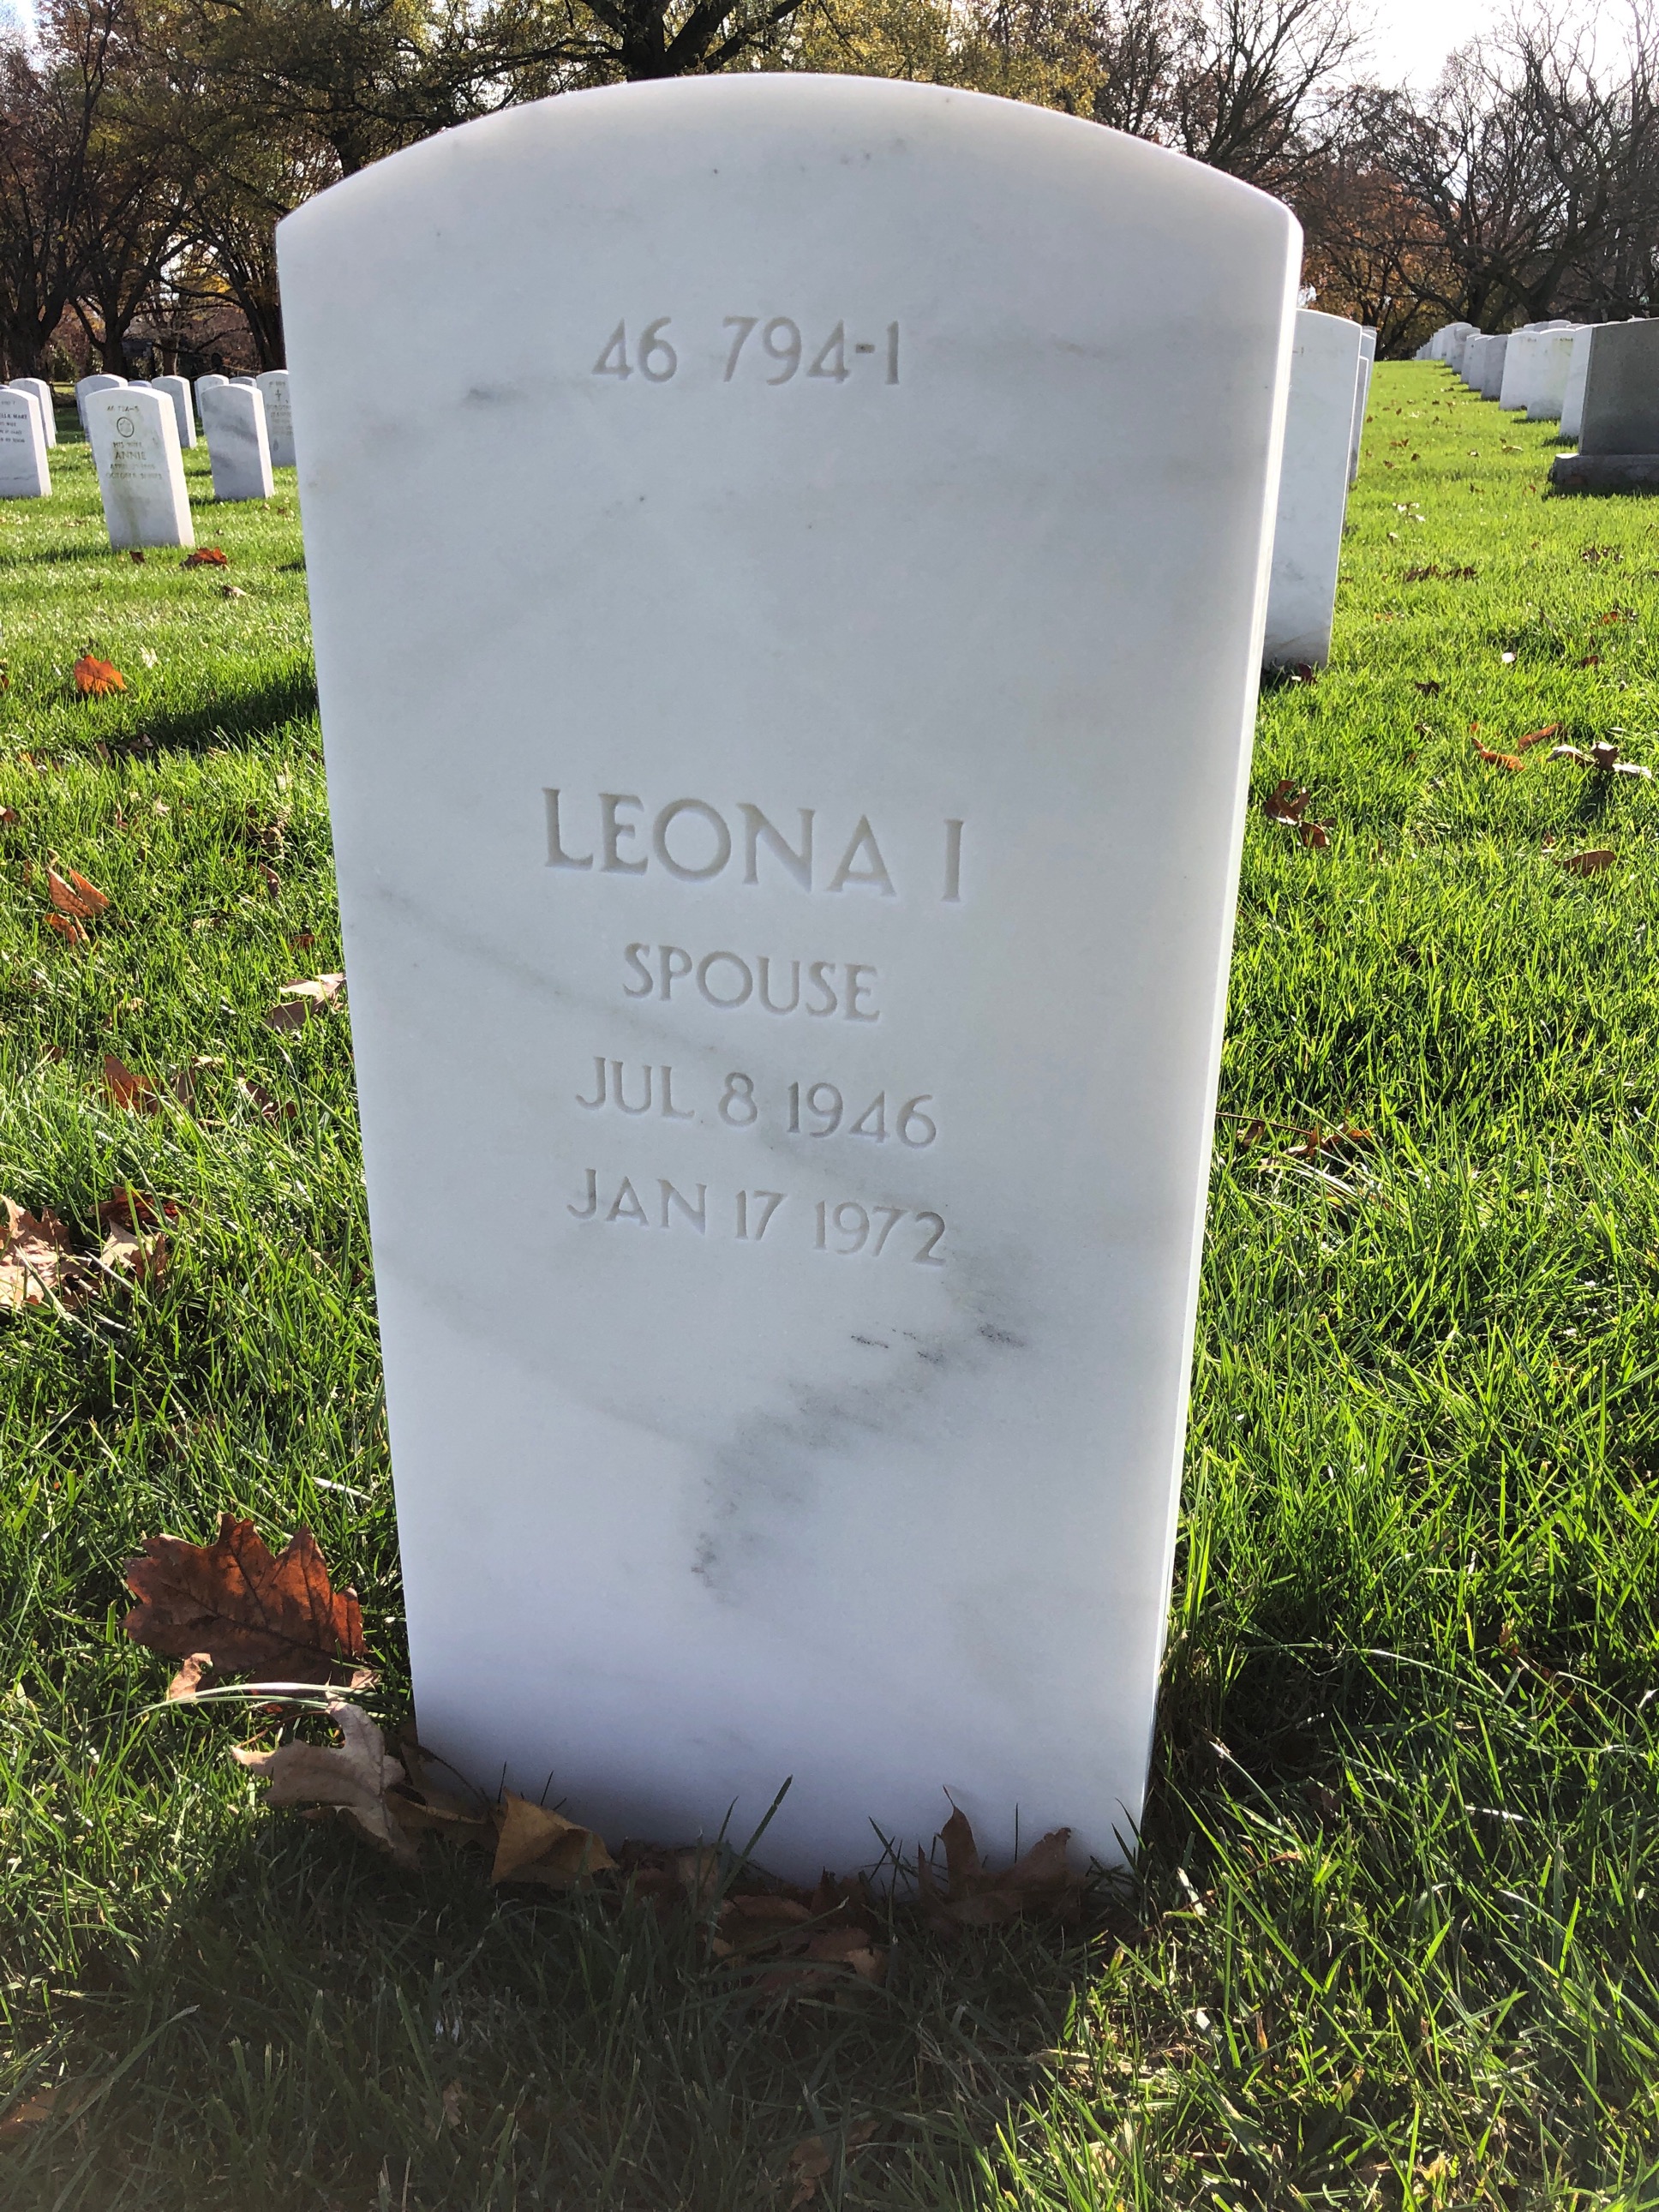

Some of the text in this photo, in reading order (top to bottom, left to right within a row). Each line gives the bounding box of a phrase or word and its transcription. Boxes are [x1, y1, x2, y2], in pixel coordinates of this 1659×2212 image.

[591, 315, 900, 386] 46 794-1
[541, 786, 965, 902] LEONA I
[622, 943, 881, 1023] SPOUSE
[575, 1056, 937, 1149] JUL 8 1946
[566, 1167, 947, 1266] JAN 17 1972
